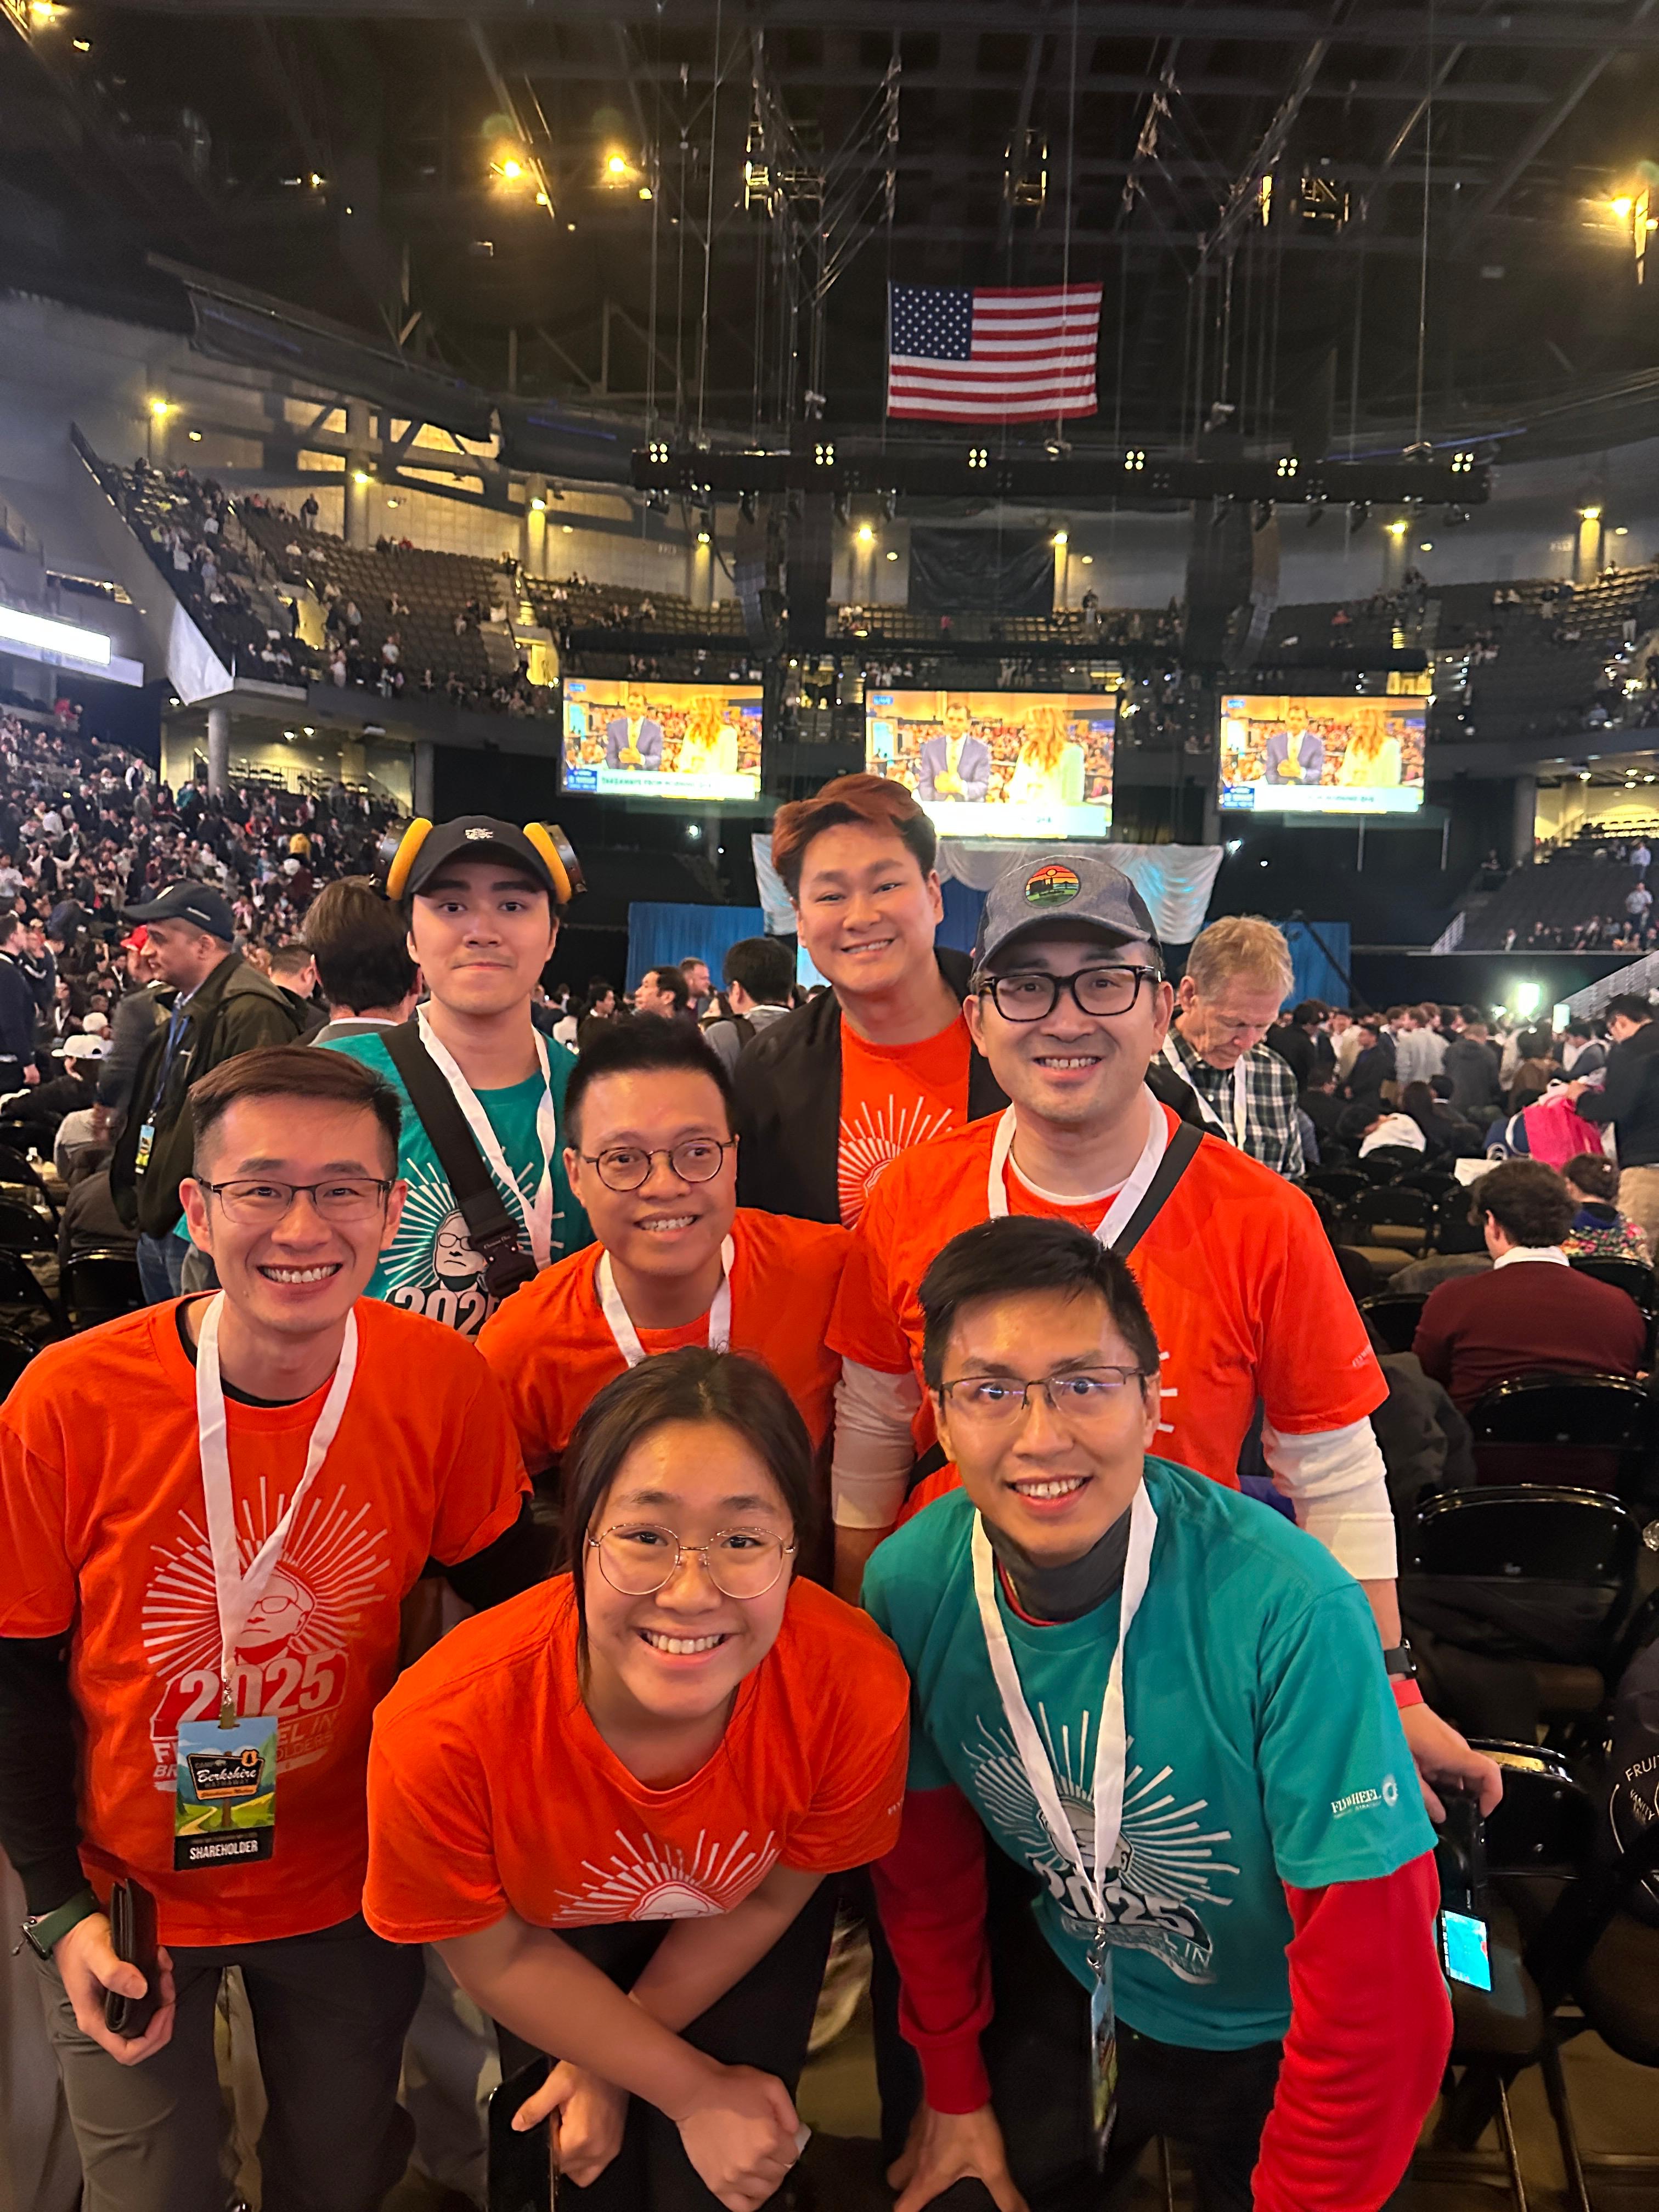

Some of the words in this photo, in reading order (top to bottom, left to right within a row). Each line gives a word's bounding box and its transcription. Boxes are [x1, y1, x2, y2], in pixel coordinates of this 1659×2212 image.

[394, 1285, 499, 1335] 202
[196, 1766, 257, 1782] Berkshire
[189, 1839, 258, 1860] SHAREHOLDER
